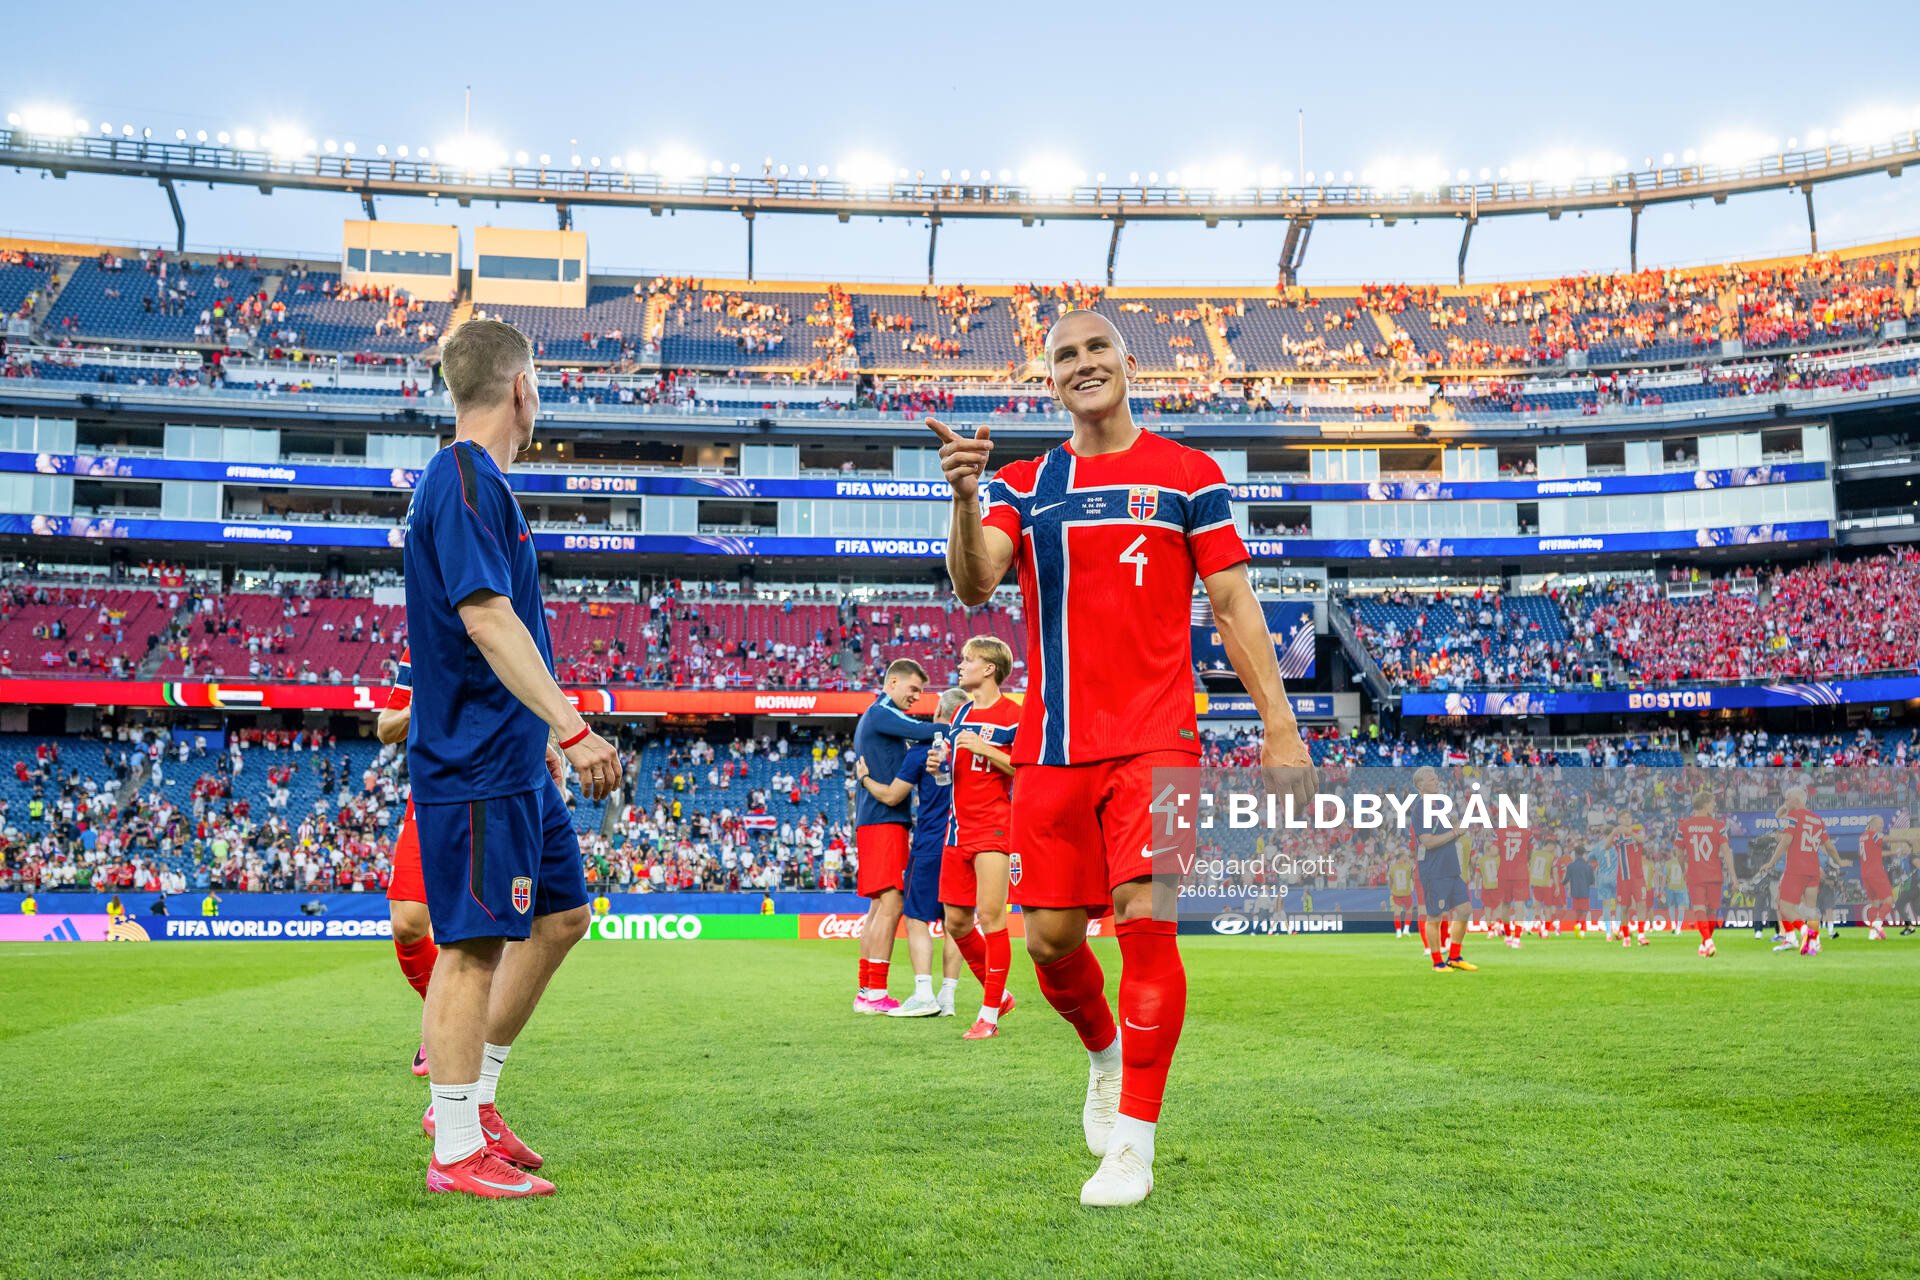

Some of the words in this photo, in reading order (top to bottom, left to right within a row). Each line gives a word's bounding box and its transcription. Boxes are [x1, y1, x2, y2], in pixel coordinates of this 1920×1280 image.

[566, 477, 637, 491] BOSTON
[836, 482, 871, 496] FIFA
[872, 483, 930, 497] WORLD
[931, 484, 954, 497] CU
[1230, 485, 1283, 498] OSTON
[564, 536, 635, 550] BOSTON
[835, 540, 870, 553] FIFA
[871, 541, 929, 554] WORLD
[1119, 533, 1148, 586] 4
[354, 686, 375, 708] 1
[755, 696, 816, 709] NORWAY
[1629, 691, 1711, 709] BOSTON
[1149, 783, 1178, 836] 4
[1755, 818, 1779, 829] FIFA
[1821, 817, 1840, 827] UP
[1504, 838, 1522, 861] 17
[1690, 833, 1713, 862] 10
[1725, 909, 1753, 927] ADI
[166, 920, 210, 936] FIFA
[211, 920, 282, 936] WORLD
[284, 920, 326, 936] CUP
[326, 920, 392, 936] 2026
[582, 914, 702, 939] ramco
